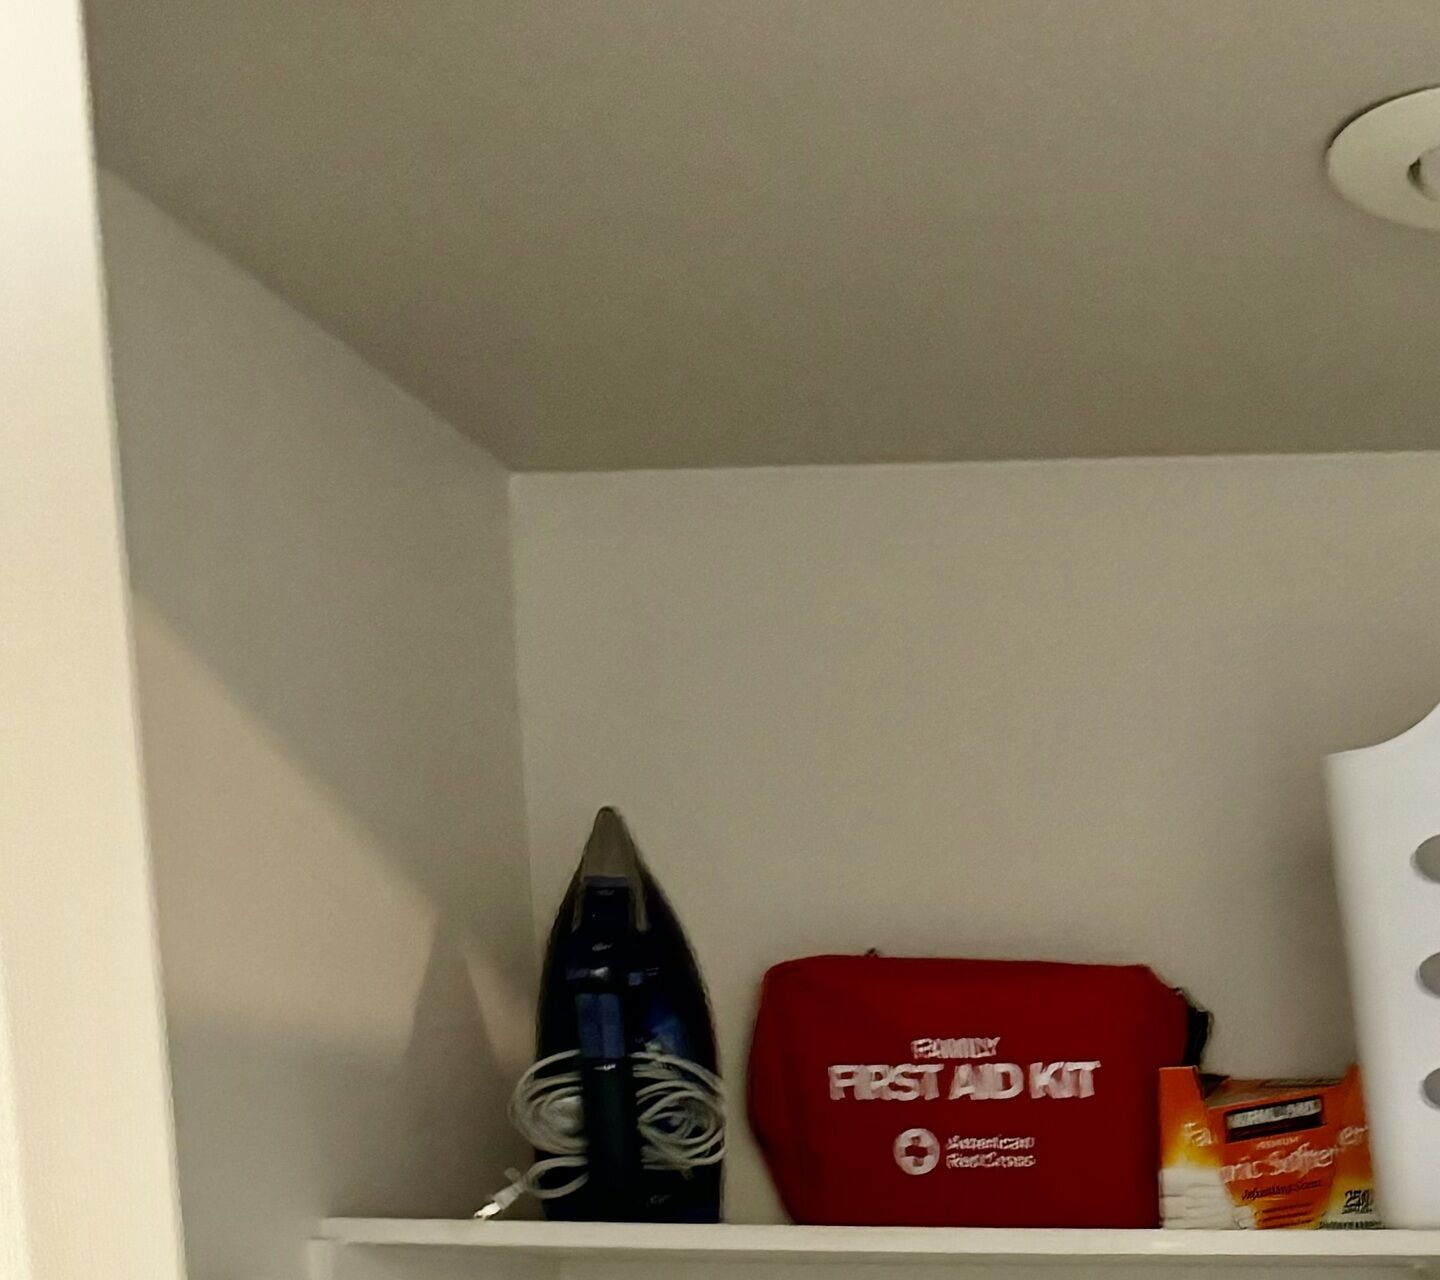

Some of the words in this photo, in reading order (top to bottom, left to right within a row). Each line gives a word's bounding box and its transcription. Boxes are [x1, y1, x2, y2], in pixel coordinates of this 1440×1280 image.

[911, 1037, 1000, 1059] FAMILY
[828, 1063, 945, 1101] FIRST
[949, 1063, 1024, 1100] AID
[1029, 1060, 1101, 1099] KIT
[946, 1134, 1036, 1150] American
